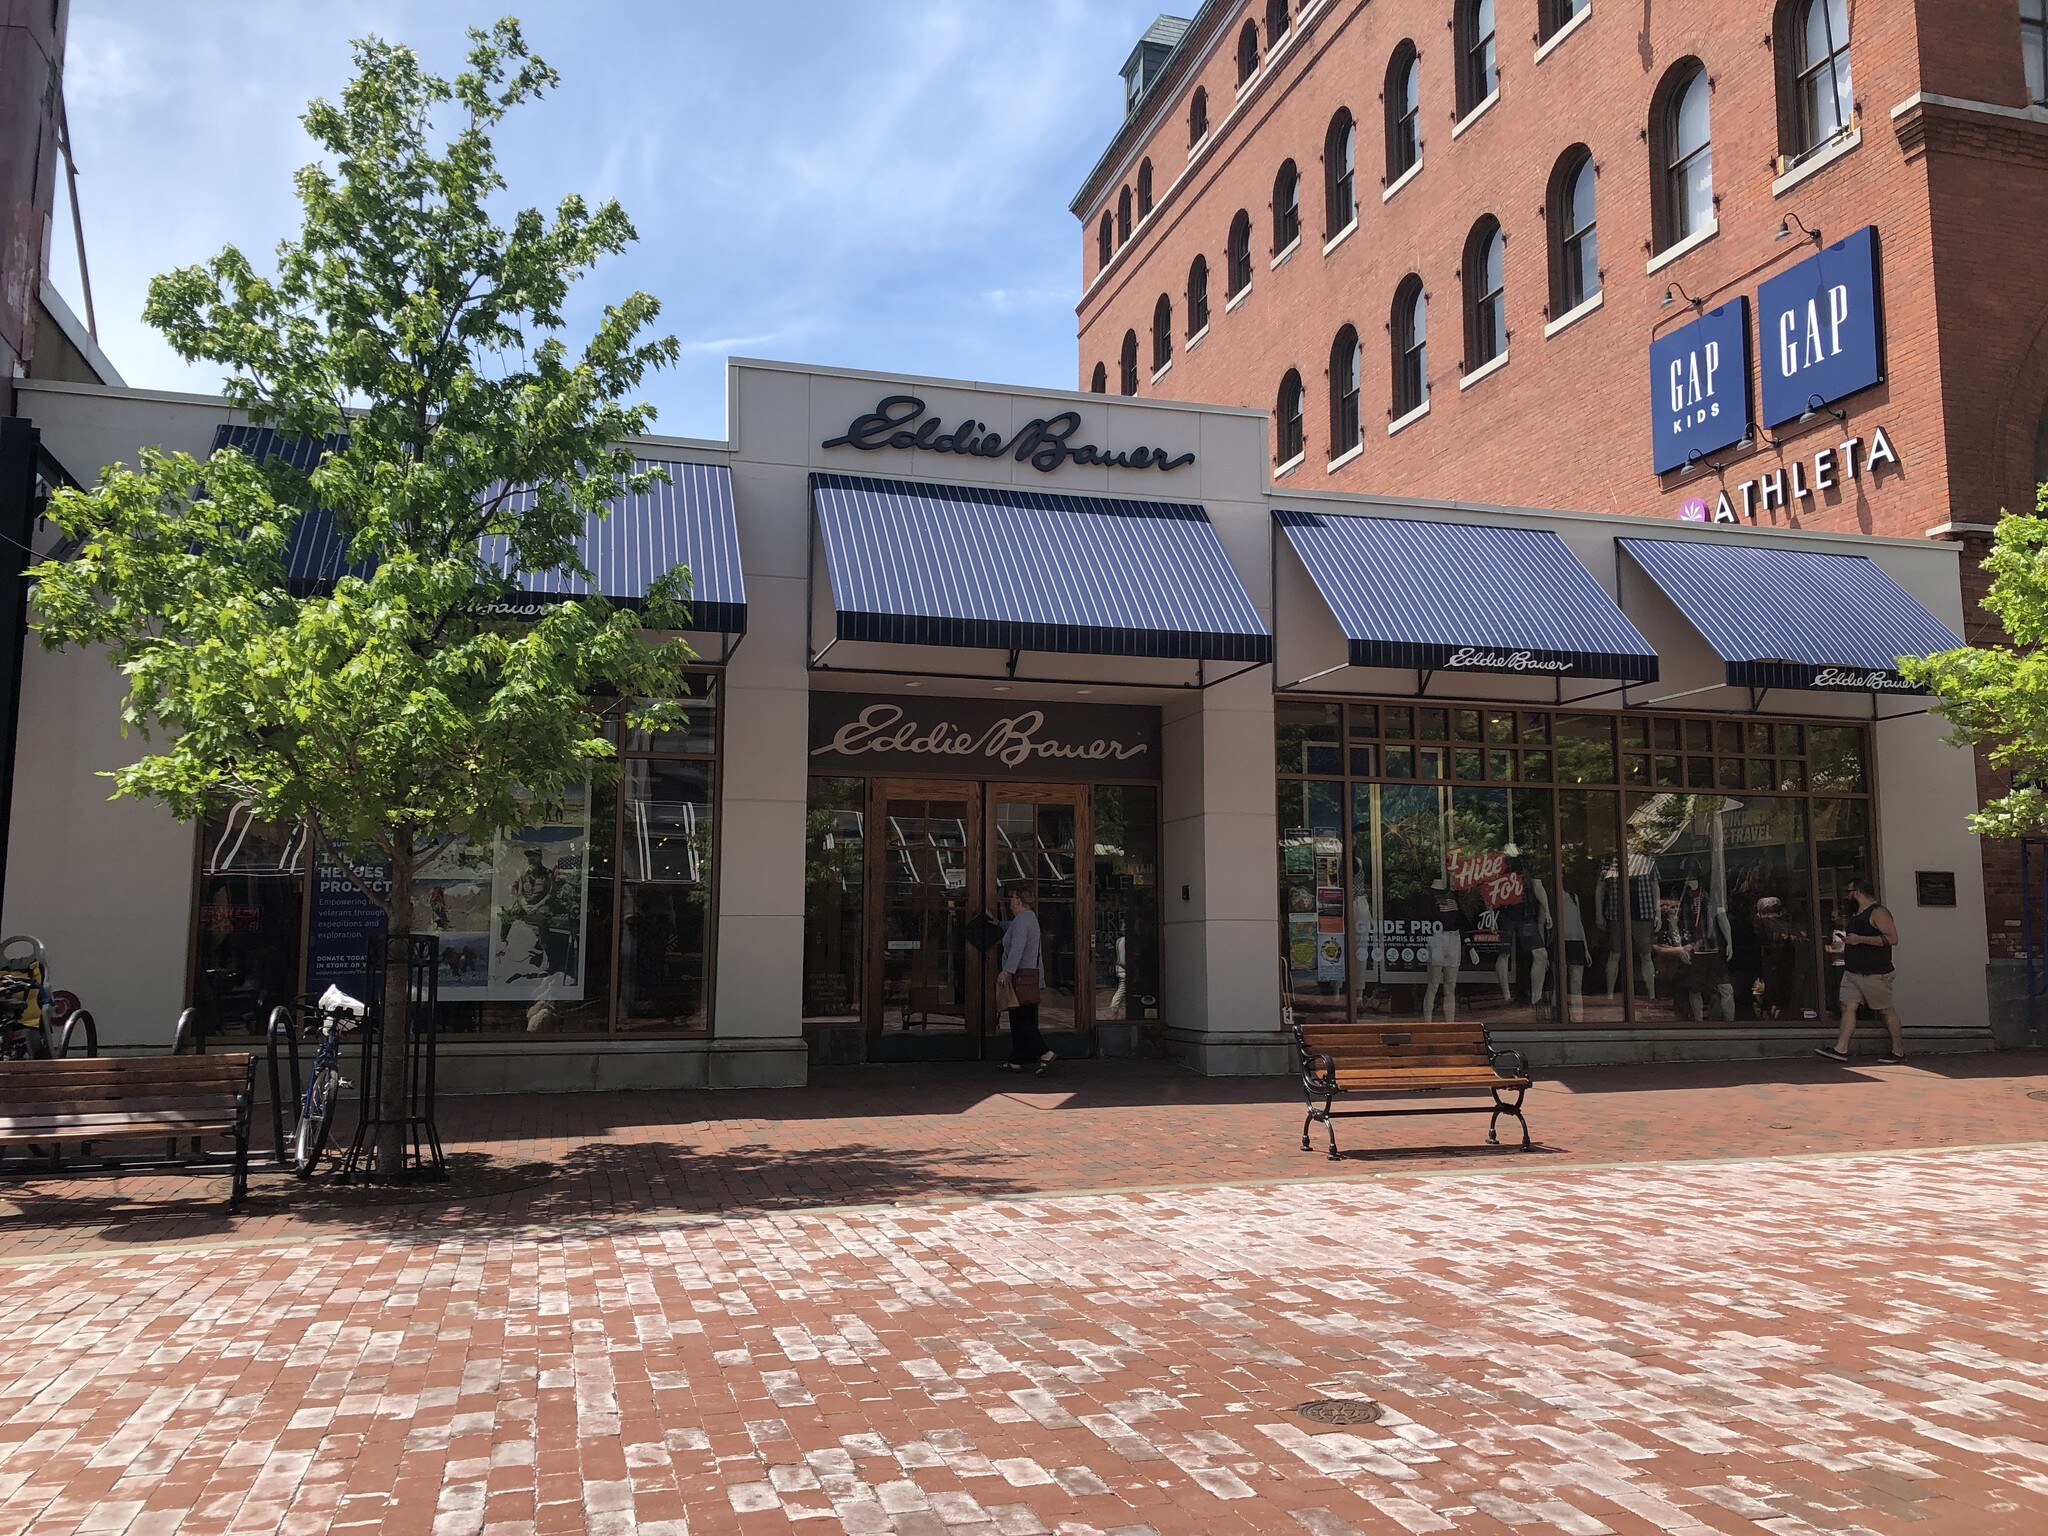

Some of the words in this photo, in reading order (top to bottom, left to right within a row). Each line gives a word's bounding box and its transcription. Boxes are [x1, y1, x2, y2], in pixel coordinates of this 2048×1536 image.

[1780, 285, 1848, 377] GAP
[1670, 341, 1719, 412] GAP
[822, 395, 1003, 457] Eddie
[1014, 411, 1195, 472] Bauer
[1673, 403, 1720, 434] KIDS
[1713, 426, 1895, 524] ATHLETA
[1443, 648, 1505, 667] Eddie
[1507, 651, 1573, 670] Bauer
[1810, 668, 1864, 686] Eddie
[1866, 671, 1923, 690] Bauer
[810, 704, 973, 755] Eddie
[984, 710, 1147, 766] Bauer
[1455, 852, 1503, 887] Hike
[318, 898, 367, 907] Empowering
[1488, 872, 1523, 905] For
[317, 920, 363, 928] expeditions
[354, 909, 385, 917] through
[1410, 920, 1444, 934] PRO
[1383, 935, 1408, 943] CAPRIS
